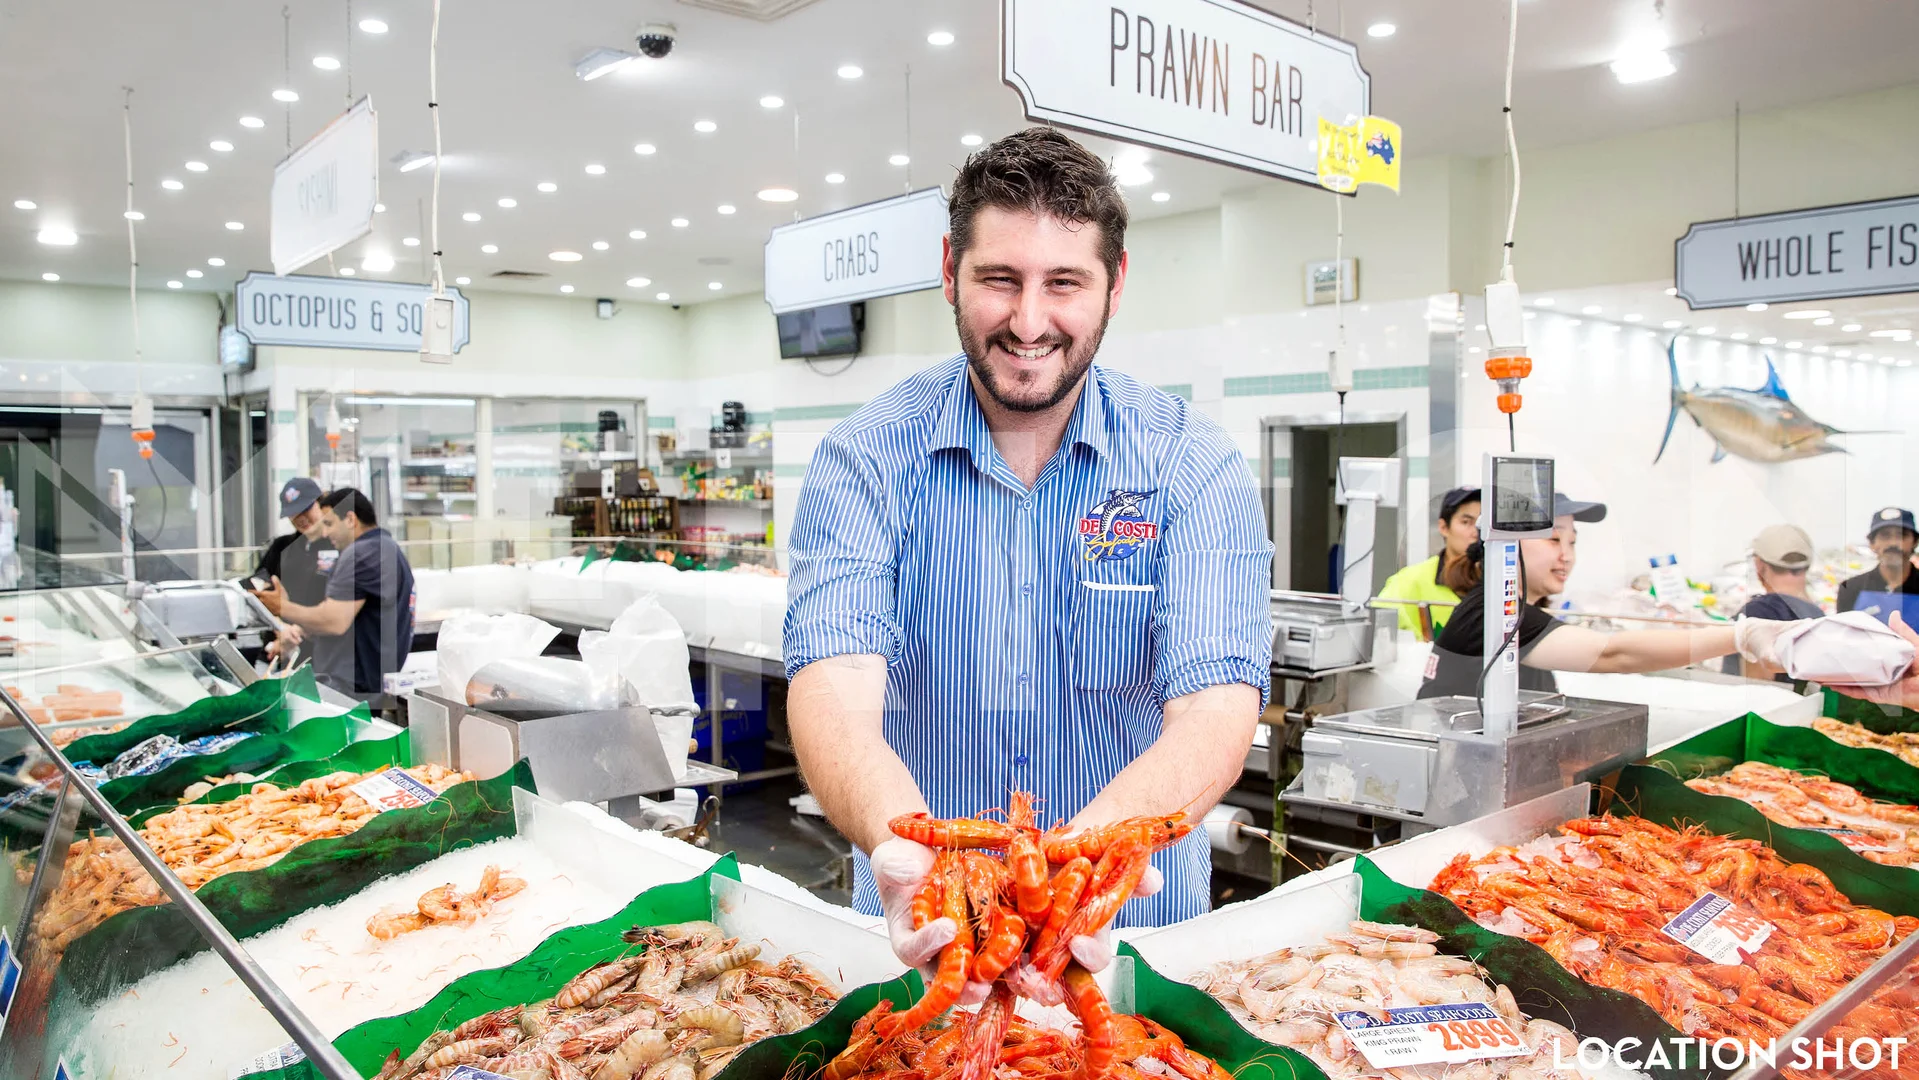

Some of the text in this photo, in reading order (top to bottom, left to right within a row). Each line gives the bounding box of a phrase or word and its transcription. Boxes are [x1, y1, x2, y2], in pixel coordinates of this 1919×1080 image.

[1110, 7, 1302, 137] PRAWN BAR
[823, 231, 880, 282] CRABS
[1737, 223, 1919, 281] WHOLE FIS
[253, 292, 357, 331] OCTOPUS
[371, 300, 383, 333] &
[1079, 518, 1157, 539] DE COSTI
[1351, 1026, 1416, 1039] LARGE GREEN
[1391, 1010, 1428, 1025] COSTI
[1429, 1008, 1493, 1021] SEAFOODS
[1364, 1035, 1422, 1047] KING PRAWN
[1428, 1018, 1519, 1051] 2899
